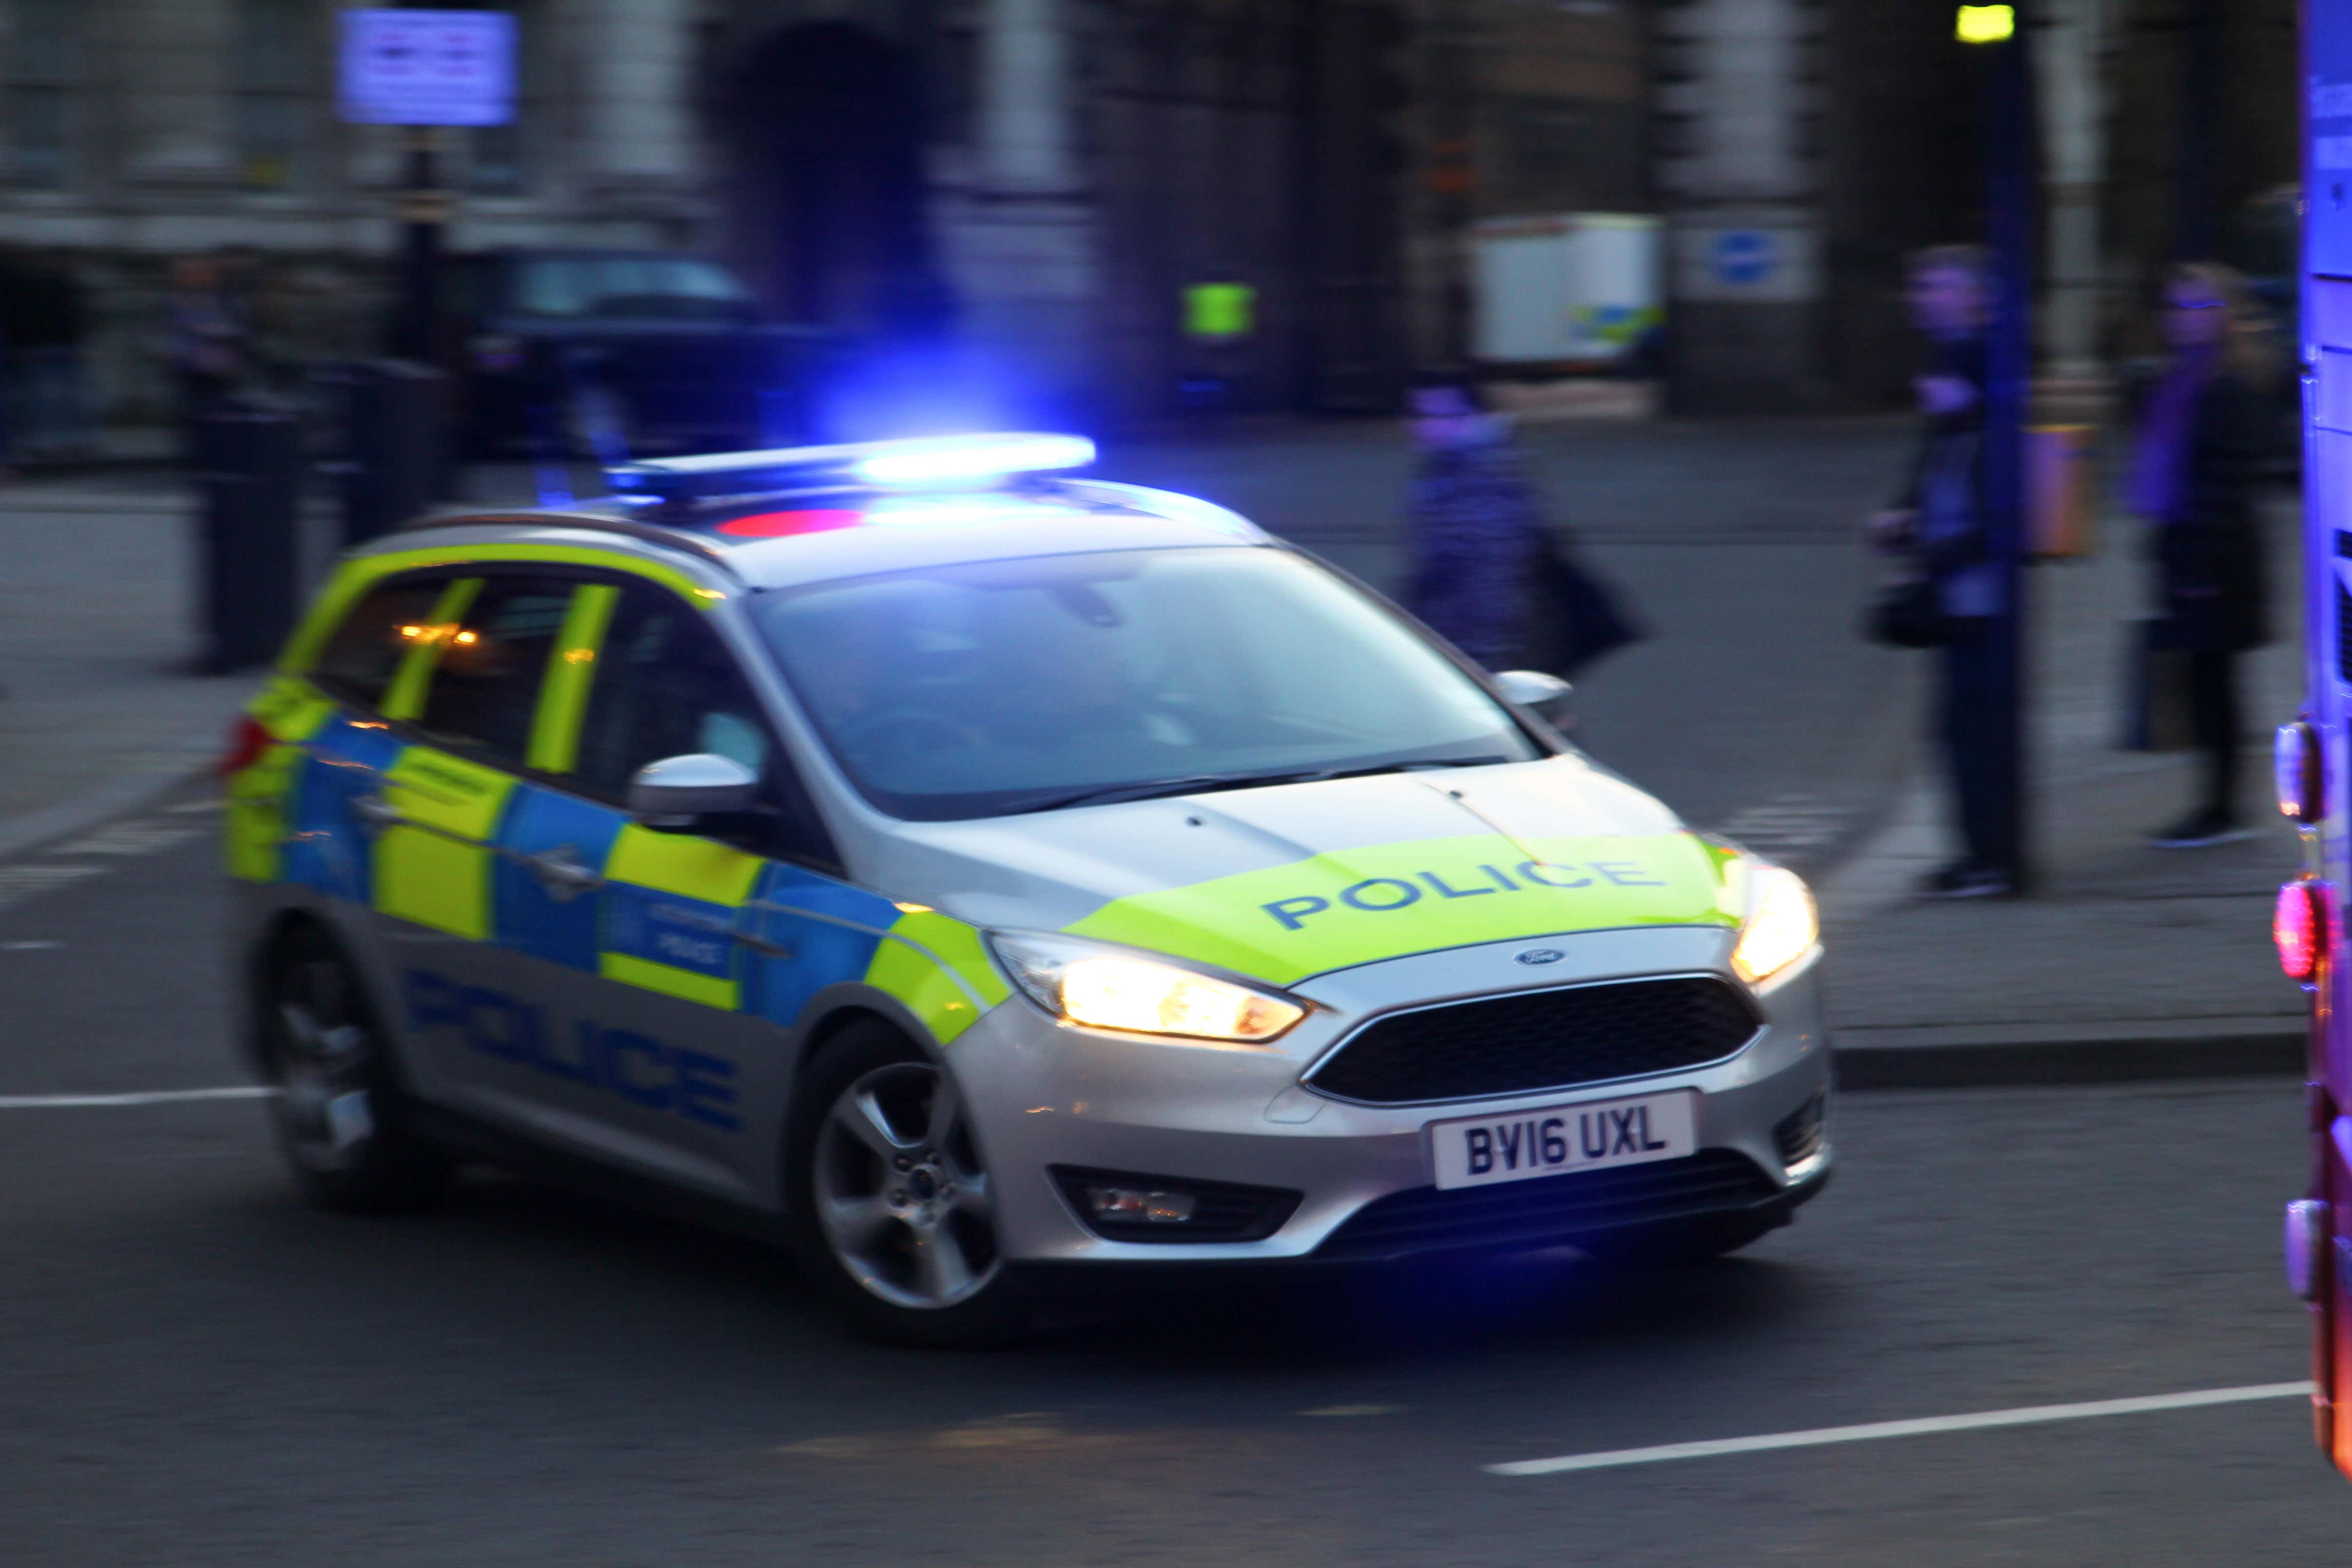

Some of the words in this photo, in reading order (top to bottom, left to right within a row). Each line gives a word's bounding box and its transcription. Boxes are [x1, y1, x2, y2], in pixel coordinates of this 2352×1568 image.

[1259, 860, 1667, 931] POLICE
[406, 969, 742, 1132] POLICE
[1464, 1117, 1567, 1176] BV16
[1579, 1105, 1667, 1160] UXL
